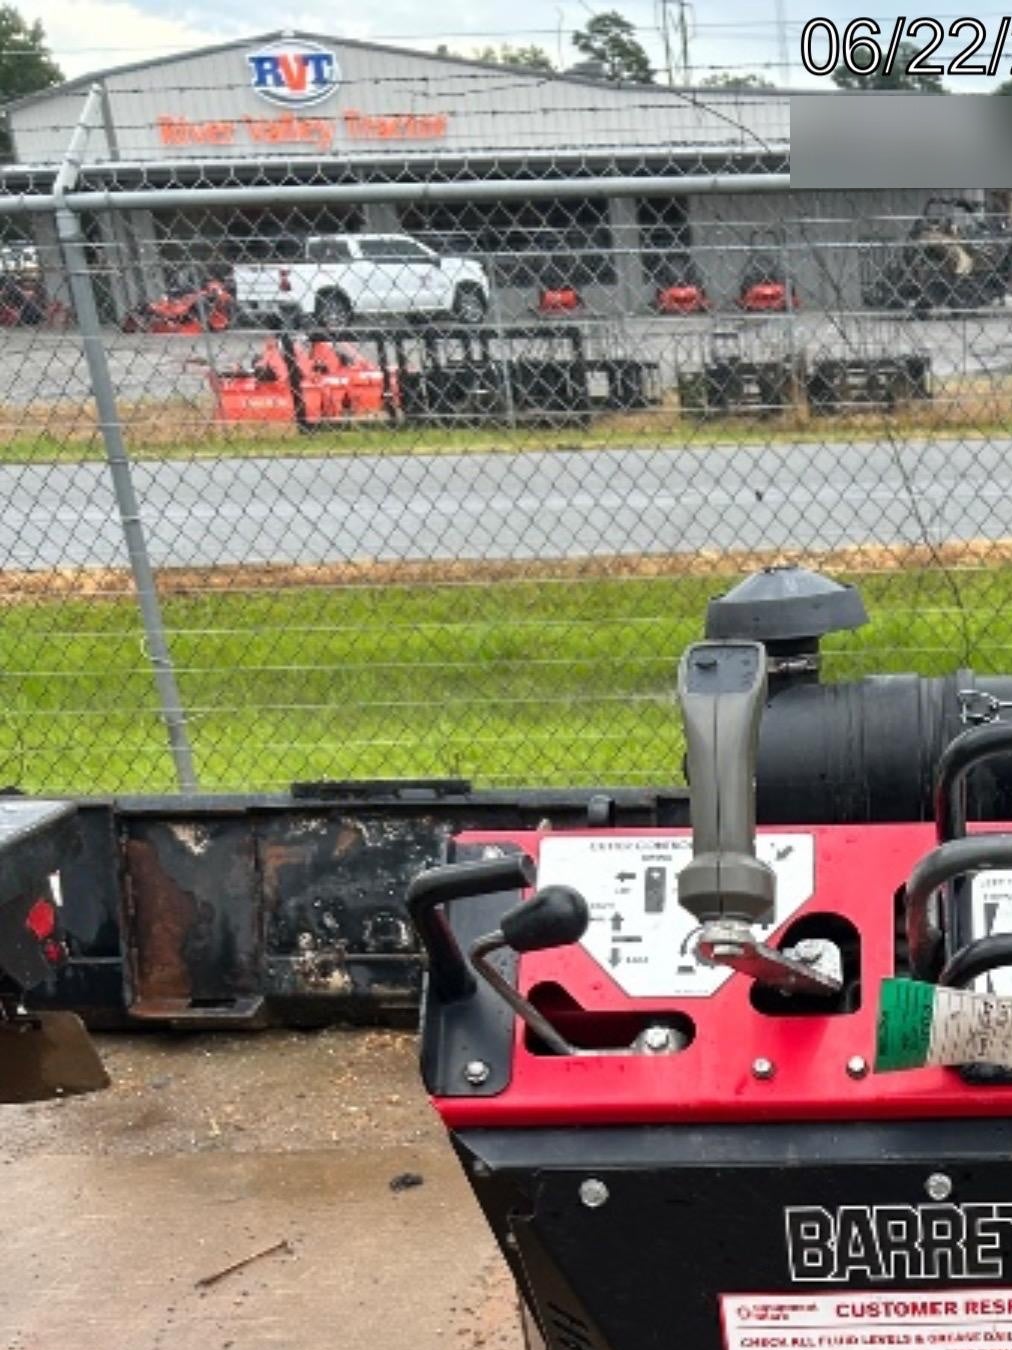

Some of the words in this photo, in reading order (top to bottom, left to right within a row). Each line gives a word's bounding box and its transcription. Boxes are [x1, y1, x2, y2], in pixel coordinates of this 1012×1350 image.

[249, 53, 334, 93] RVT
[836, 1301, 957, 1317] CUSTOMER
[861, 1334, 912, 1344] LEVELS
